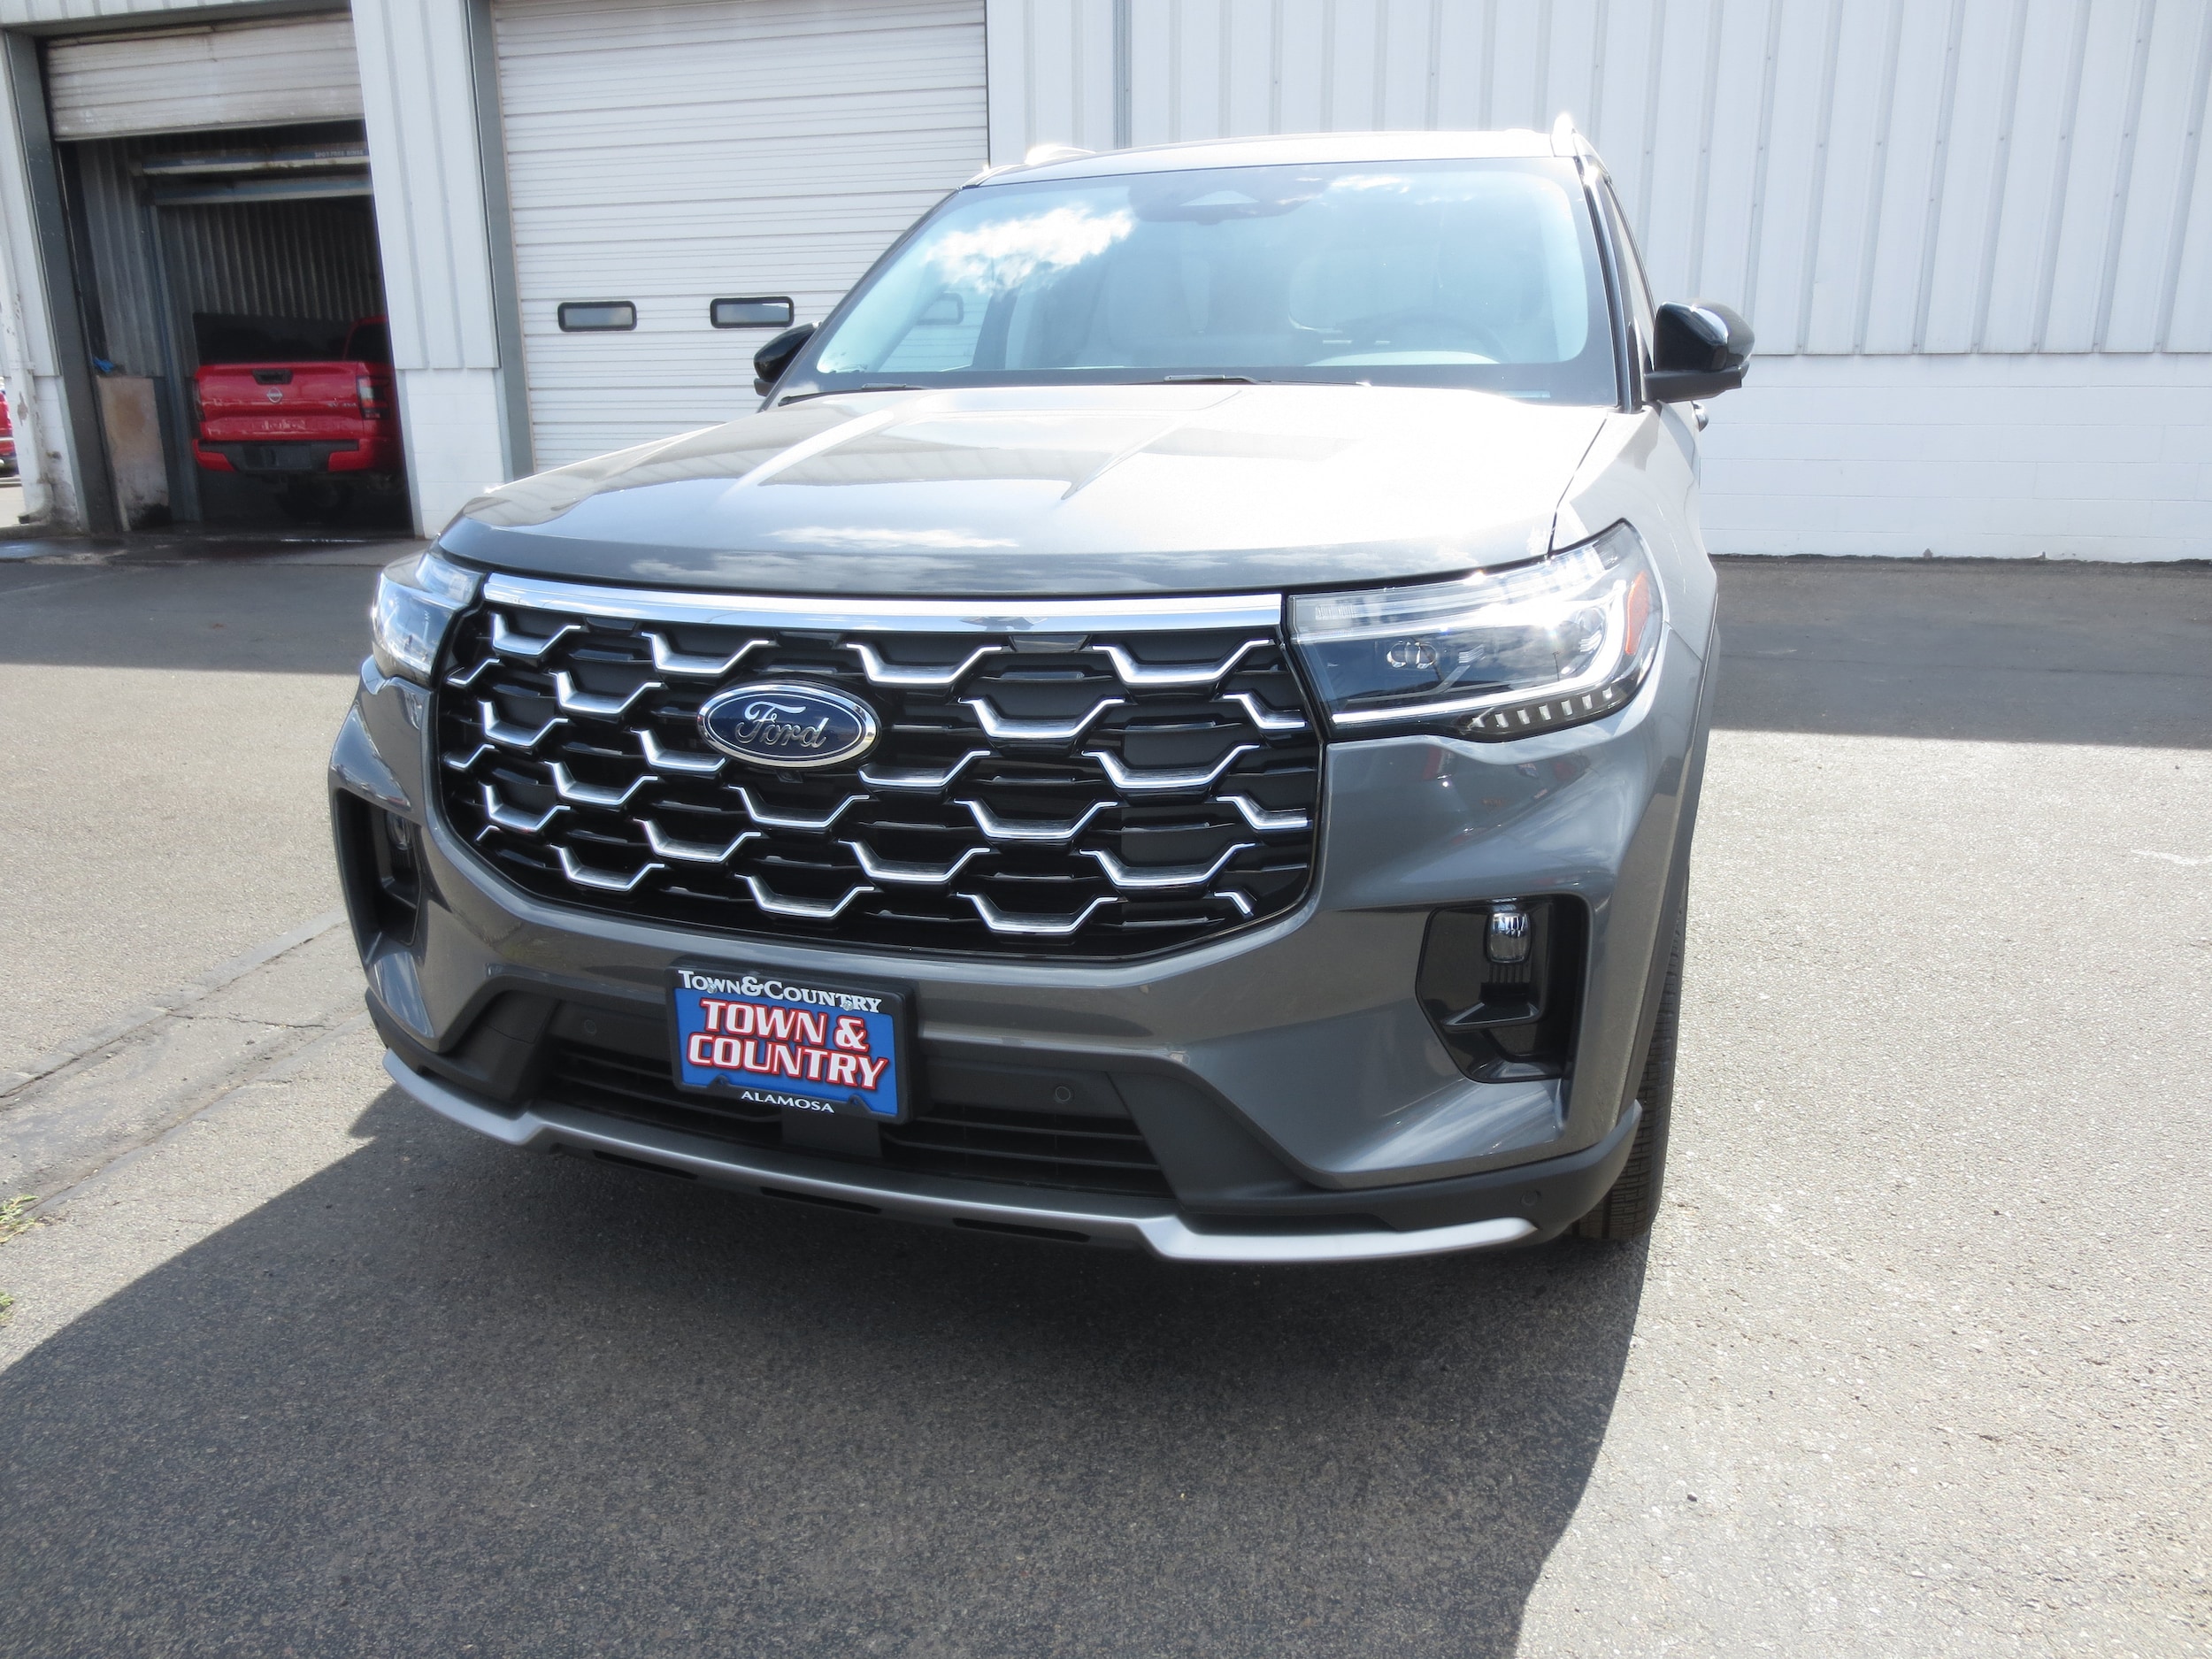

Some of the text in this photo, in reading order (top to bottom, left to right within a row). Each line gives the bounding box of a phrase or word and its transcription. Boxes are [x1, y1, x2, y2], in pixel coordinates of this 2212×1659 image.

[735, 701, 830, 749] Ford
[700, 998, 869, 1052] TOWN &
[687, 1033, 889, 1089] COUNTRY
[741, 1090, 835, 1113] ALAMOSA
